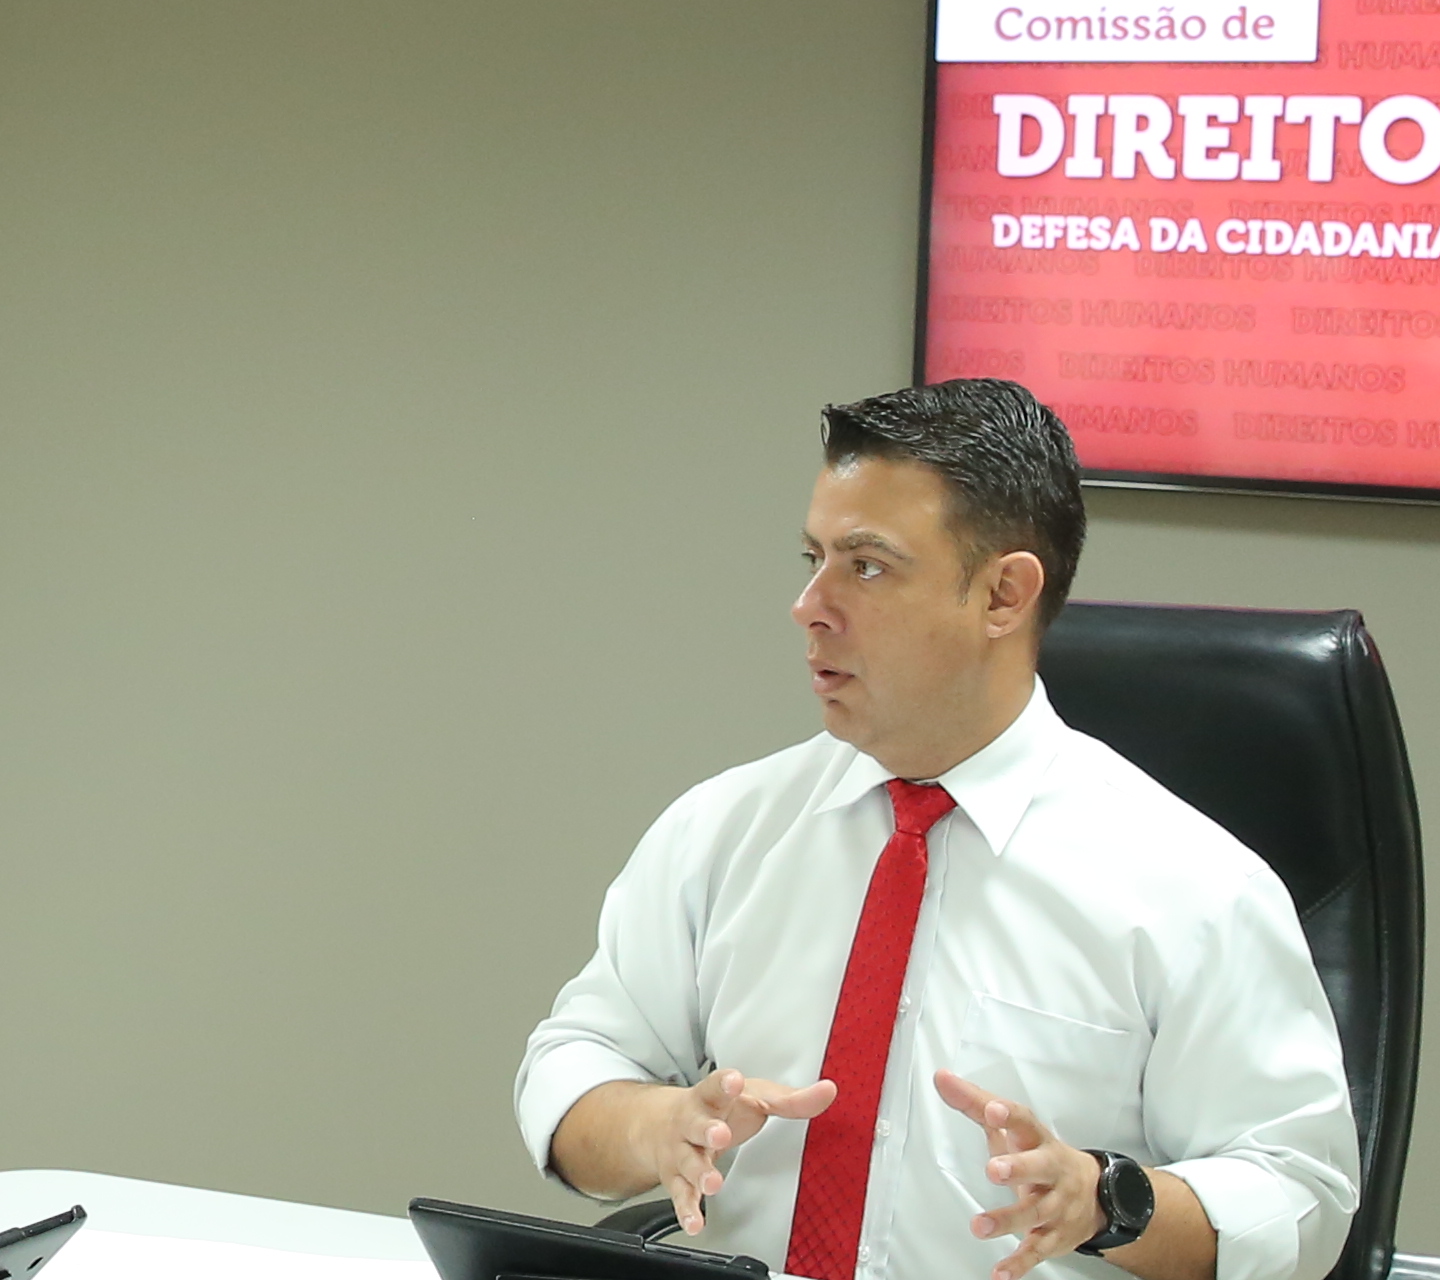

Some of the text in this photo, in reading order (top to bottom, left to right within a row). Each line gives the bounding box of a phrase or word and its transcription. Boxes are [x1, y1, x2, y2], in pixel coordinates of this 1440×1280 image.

[994, 5, 1275, 42] Comissão de
[992, 215, 1140, 253] DEFESA
[1150, 218, 1208, 254] DA
[1060, 352, 1406, 393] DIREITOS HUMANOS
